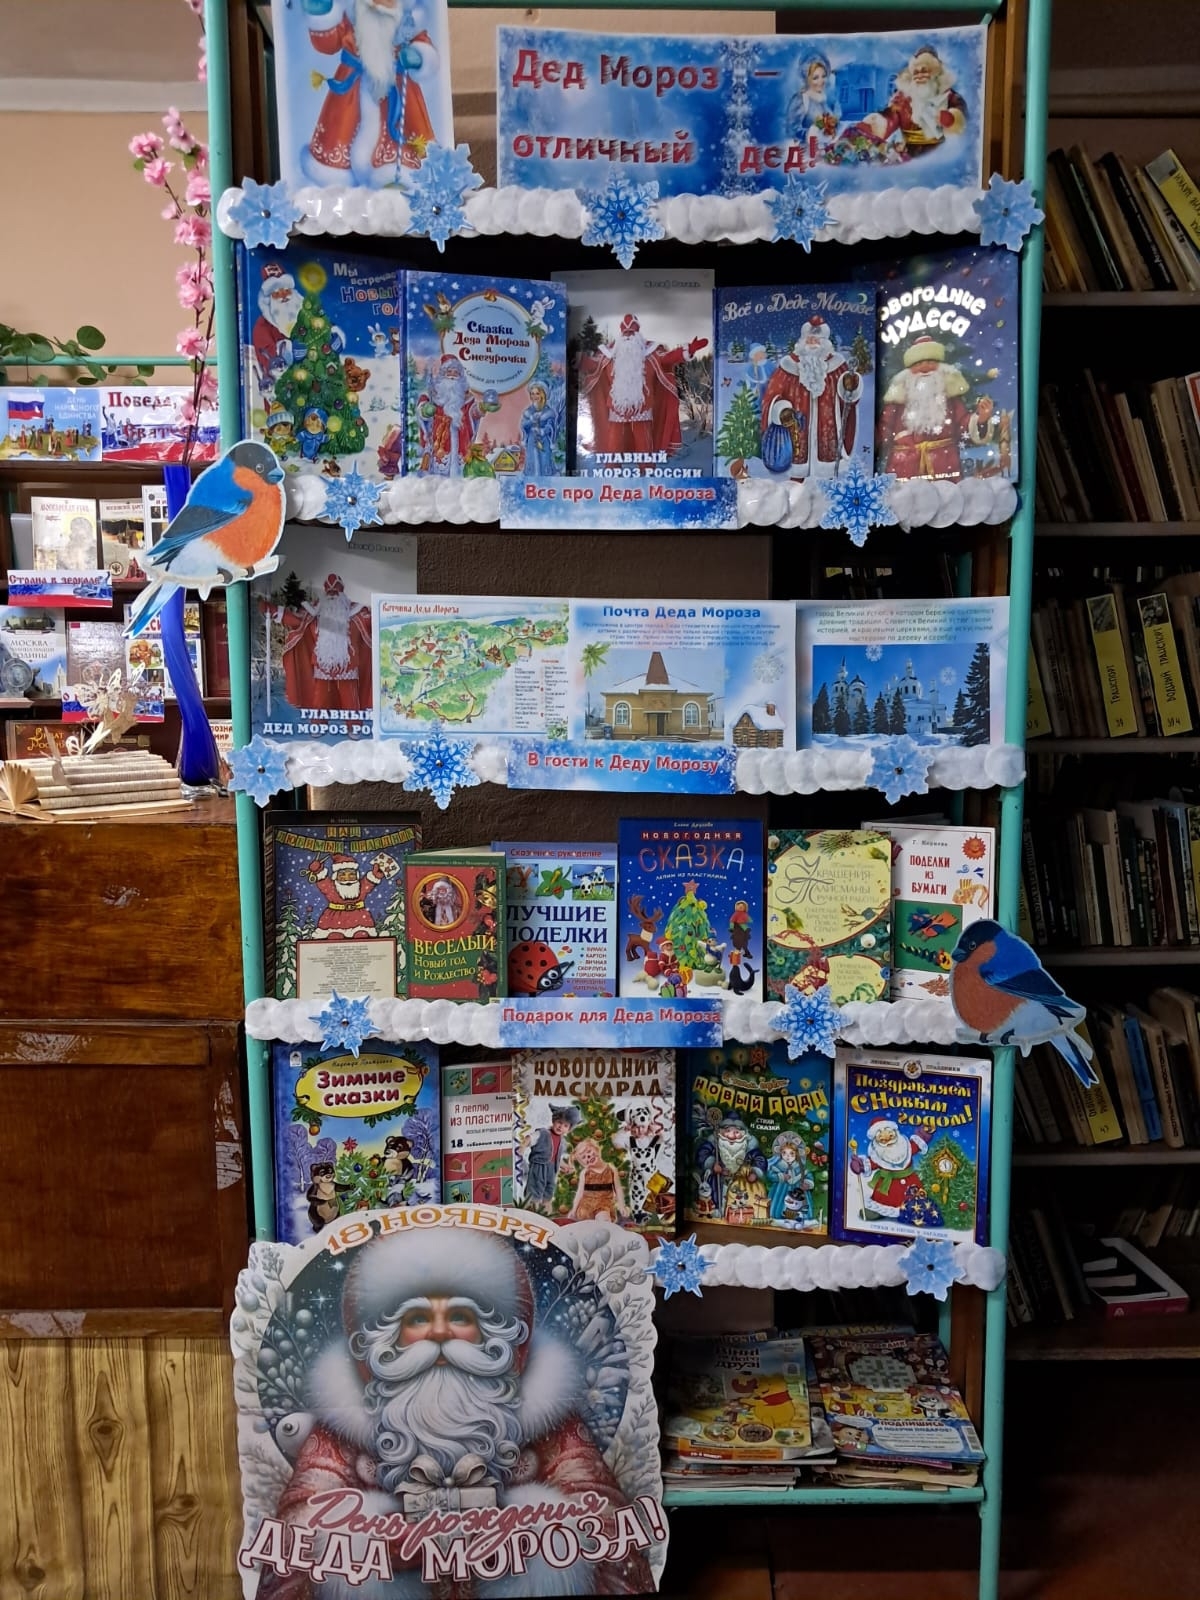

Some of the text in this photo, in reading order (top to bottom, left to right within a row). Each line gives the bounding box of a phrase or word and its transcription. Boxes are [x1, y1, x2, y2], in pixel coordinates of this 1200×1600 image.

[512, 49, 586, 89] Дед
[600, 54, 719, 97] Мороз
[512, 130, 819, 174] отличный дед!
[333, 262, 358, 277] Мы
[723, 301, 752, 322] Всё
[754, 303, 764, 314] о
[767, 293, 810, 313] Деде
[467, 320, 514, 335] Сказки
[453, 331, 530, 348] Деда Мороза
[459, 347, 527, 365] Снегурочки
[596, 450, 668, 464] ГЛАВНЫЙ
[593, 468, 702, 477] МОРОЗ РОССИИ
[525, 484, 715, 503] Все про Деда Мороза
[9, 575, 47, 586] Страна
[414, 603, 431, 614] Деда
[433, 604, 459, 615] Мороза
[603, 606, 761, 621] Почта Деда Мороза
[10, 639, 48, 647] МОСКВА
[263, 723, 373, 735] ДЕД МОРОЗ РО
[528, 753, 719, 773] В гости к Деду Морозу
[642, 831, 742, 840] НОВОГОДНЯЯ
[638, 843, 745, 873] СКАЗКА
[910, 855, 950, 868] ПОДЕЛКИ
[925, 871, 934, 880] ИЗ
[911, 882, 947, 895] БУМАГИ
[507, 906, 607, 922] ЛУЧШИЕ
[414, 935, 496, 957] ВЕСЕЛЫЙ
[503, 1008, 721, 1025] Подарок для Деда Мороза
[534, 1056, 659, 1078] НОВОГОДНИЙ
[317, 1068, 406, 1089] Зимние
[855, 1073, 972, 1098] Поздравляем
[533, 1078, 664, 1097] МАСКАРАД
[694, 1077, 761, 1110] НОВЫЙ
[771, 1092, 823, 1110] ГОД!
[324, 1088, 400, 1107] сказки
[872, 1093, 947, 1115] Новым
[455, 1104, 489, 1113] Я леплю
[450, 1117, 462, 1126] из
[898, 1105, 974, 1133] годом!
[451, 1138, 464, 1149] 18
[326, 1206, 553, 1254] 18 НОЯБРЯ
[309, 1489, 609, 1563] День рождения
[240, 1496, 667, 1586] ДЕДА МОРОЗА!
